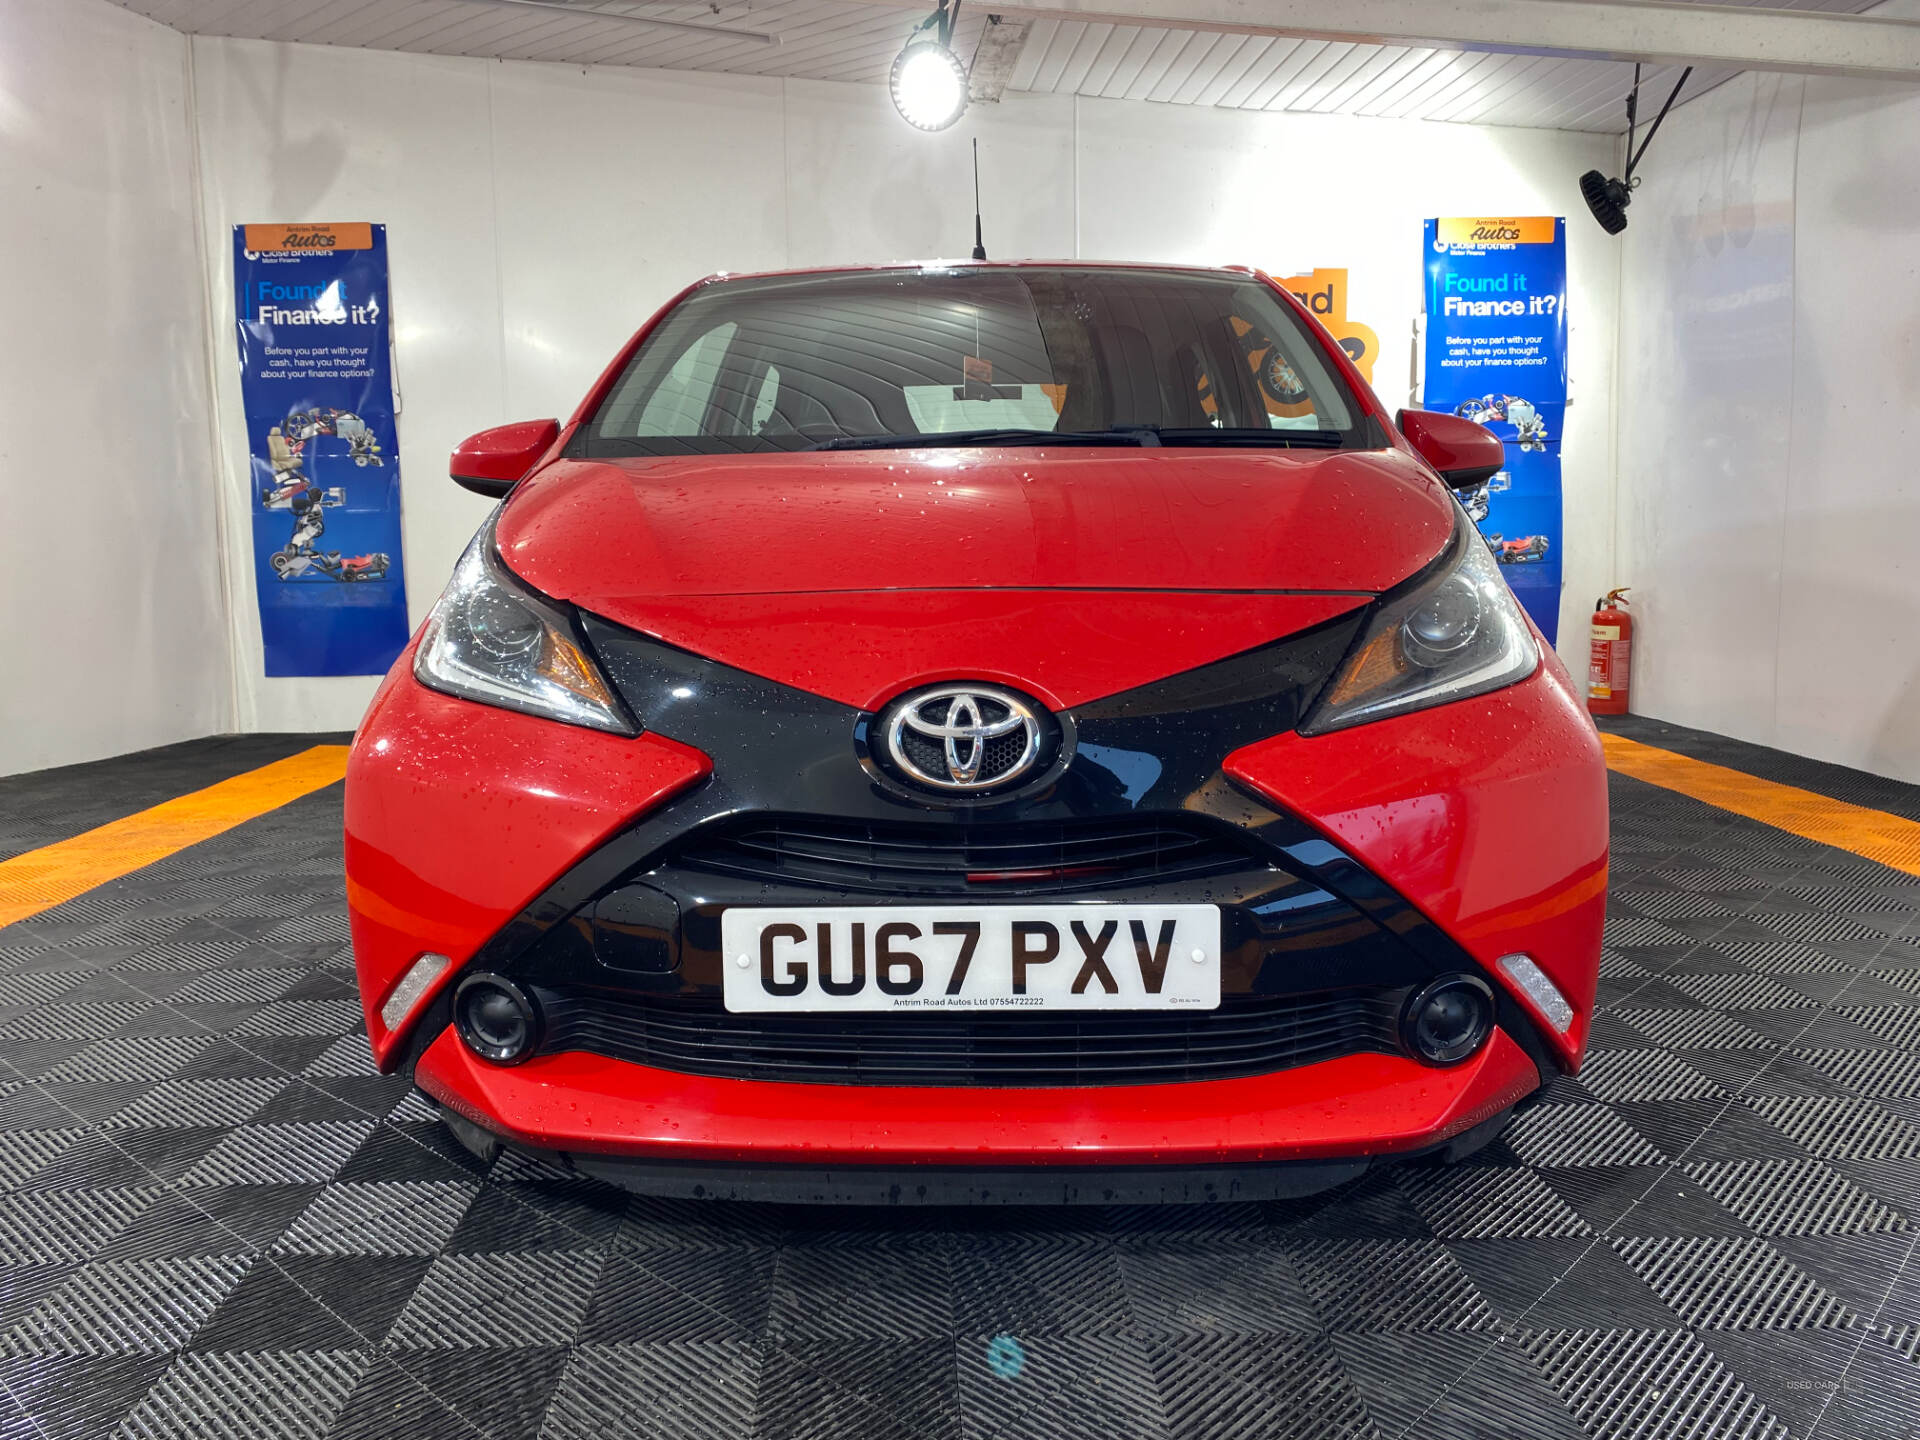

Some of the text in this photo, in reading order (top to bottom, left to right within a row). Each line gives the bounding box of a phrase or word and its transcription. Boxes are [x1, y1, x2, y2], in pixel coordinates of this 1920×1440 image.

[1470, 226, 1521, 241] Autos
[281, 232, 337, 248] Autos
[1444, 273, 1528, 293] Found it
[1444, 294, 1558, 317] Finance it?
[258, 304, 380, 325] Finan it?
[1446, 336, 1543, 346] Before you part with your
[264, 346, 368, 357] Before you part with your
[1449, 346, 1539, 357] cash, have you thought
[269, 358, 366, 368] cash, have you thought
[1441, 356, 1548, 368] about your finance options?
[261, 368, 375, 379] about your finance options?
[760, 919, 1177, 997] GU67 PXV
[893, 997, 1044, 1007] Antrim Road Autos Ltd 07554722222
